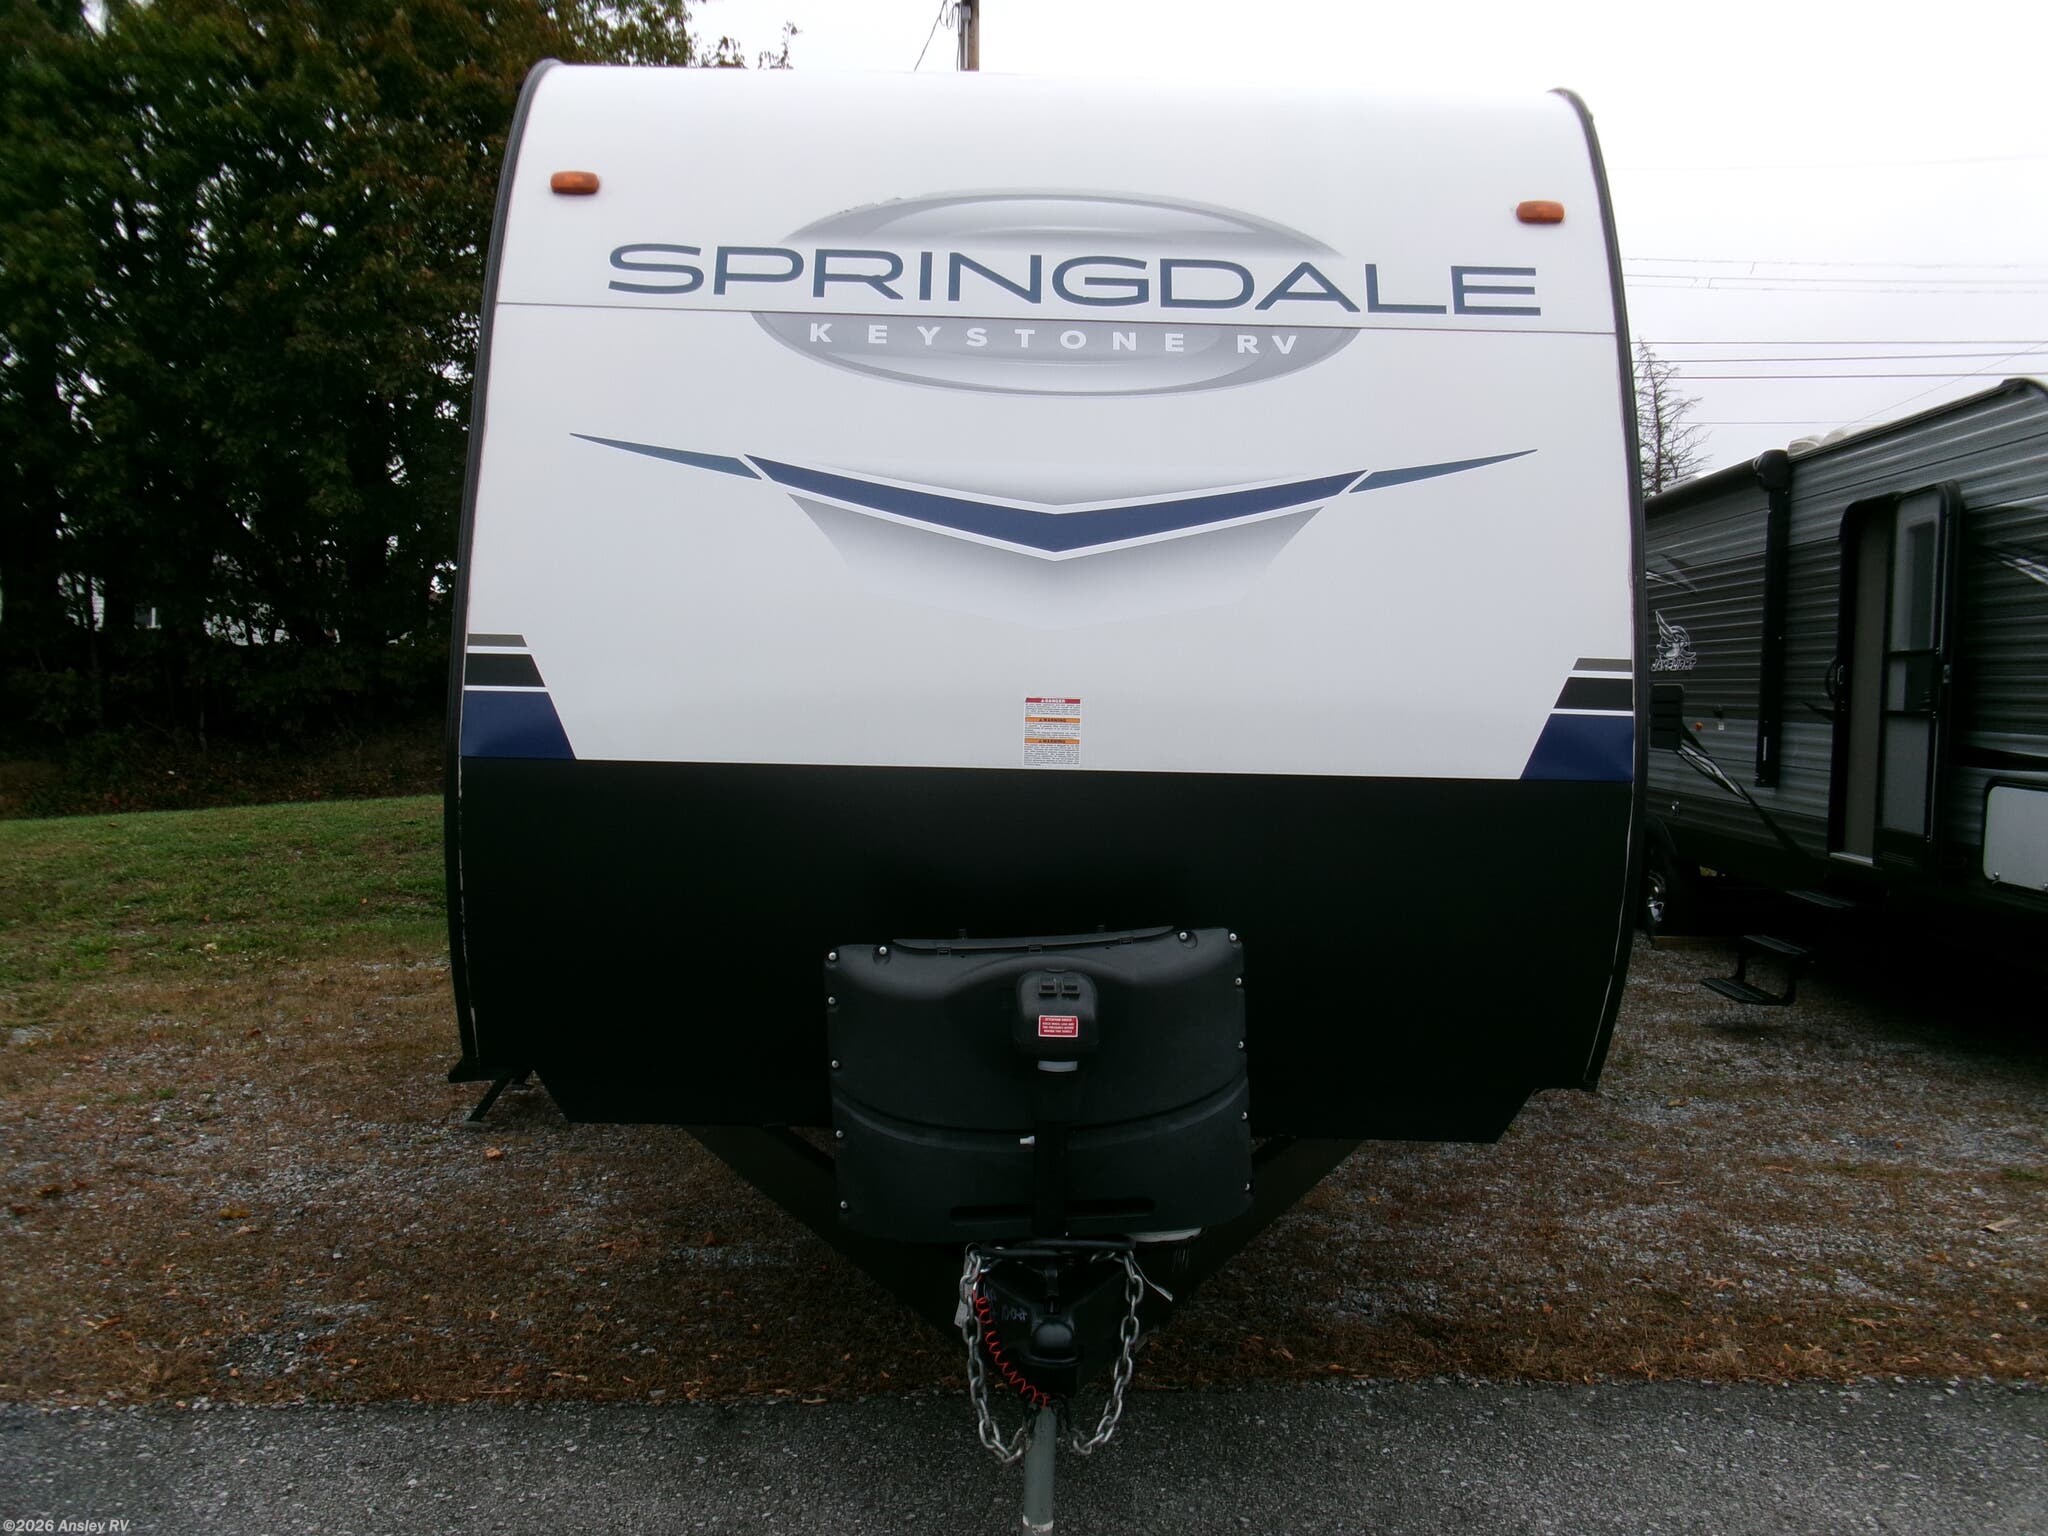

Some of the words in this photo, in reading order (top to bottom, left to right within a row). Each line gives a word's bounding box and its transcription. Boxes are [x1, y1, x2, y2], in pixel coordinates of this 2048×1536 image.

[609, 244, 1541, 315] SPRINGDALE
[809, 323, 1185, 353] KEYSTONE
[1237, 334, 1297, 355] RV
